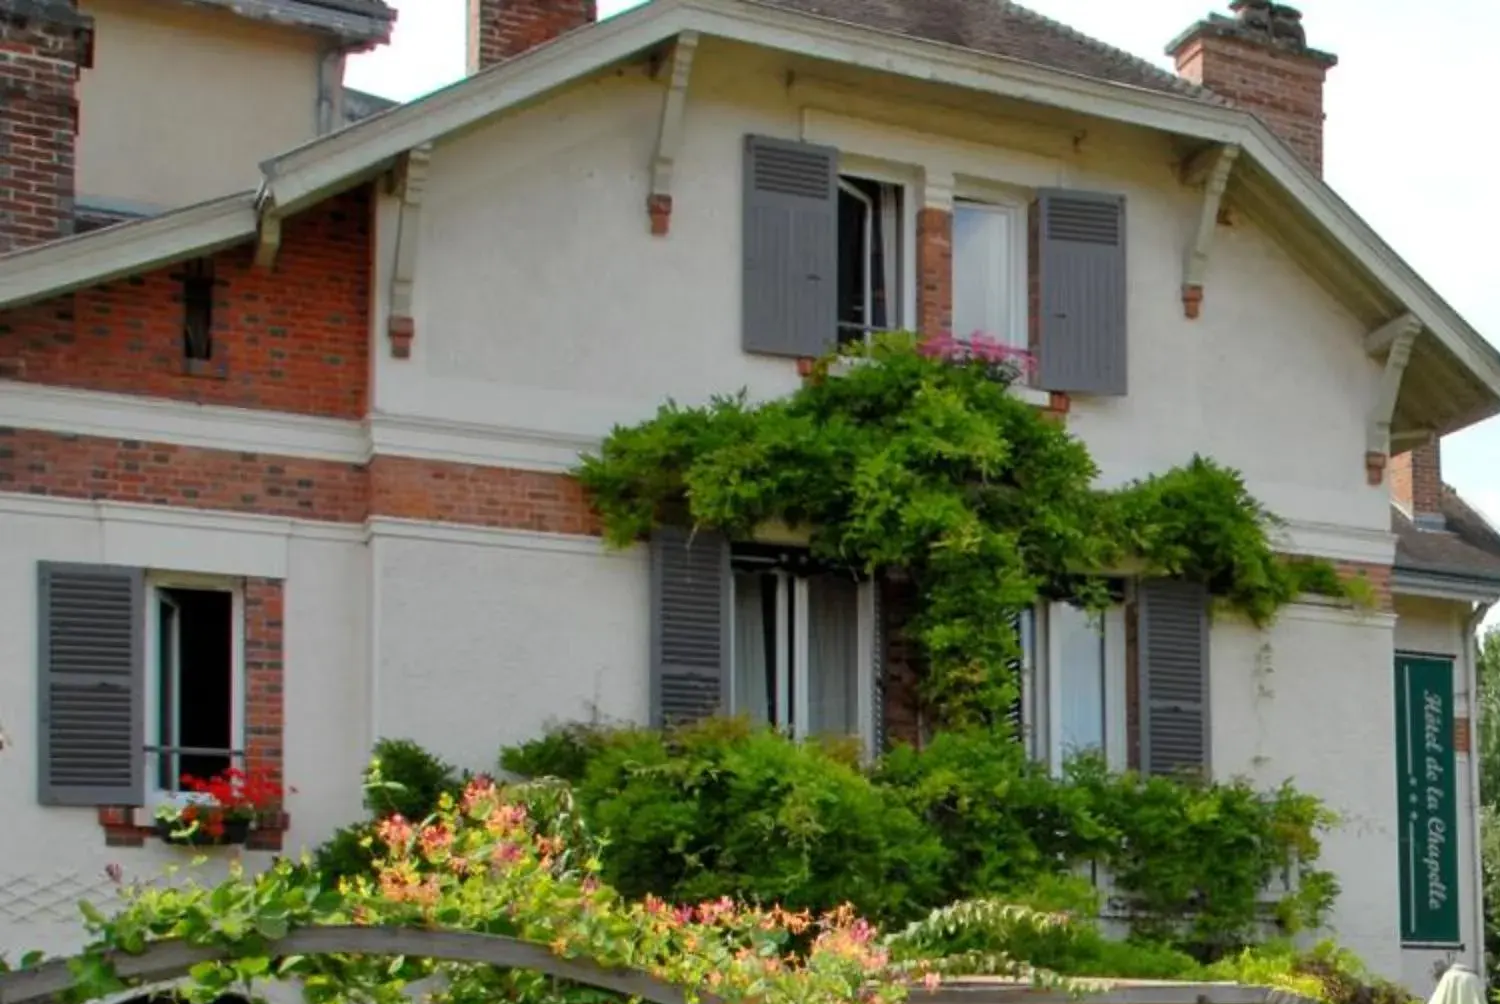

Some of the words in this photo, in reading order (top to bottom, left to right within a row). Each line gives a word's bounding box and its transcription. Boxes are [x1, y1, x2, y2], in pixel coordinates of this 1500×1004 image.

[1424, 690, 1443, 752] Hôtel
[1425, 756, 1444, 781] de
[1426, 786, 1444, 811] la
[1422, 816, 1447, 911] Chapelle
